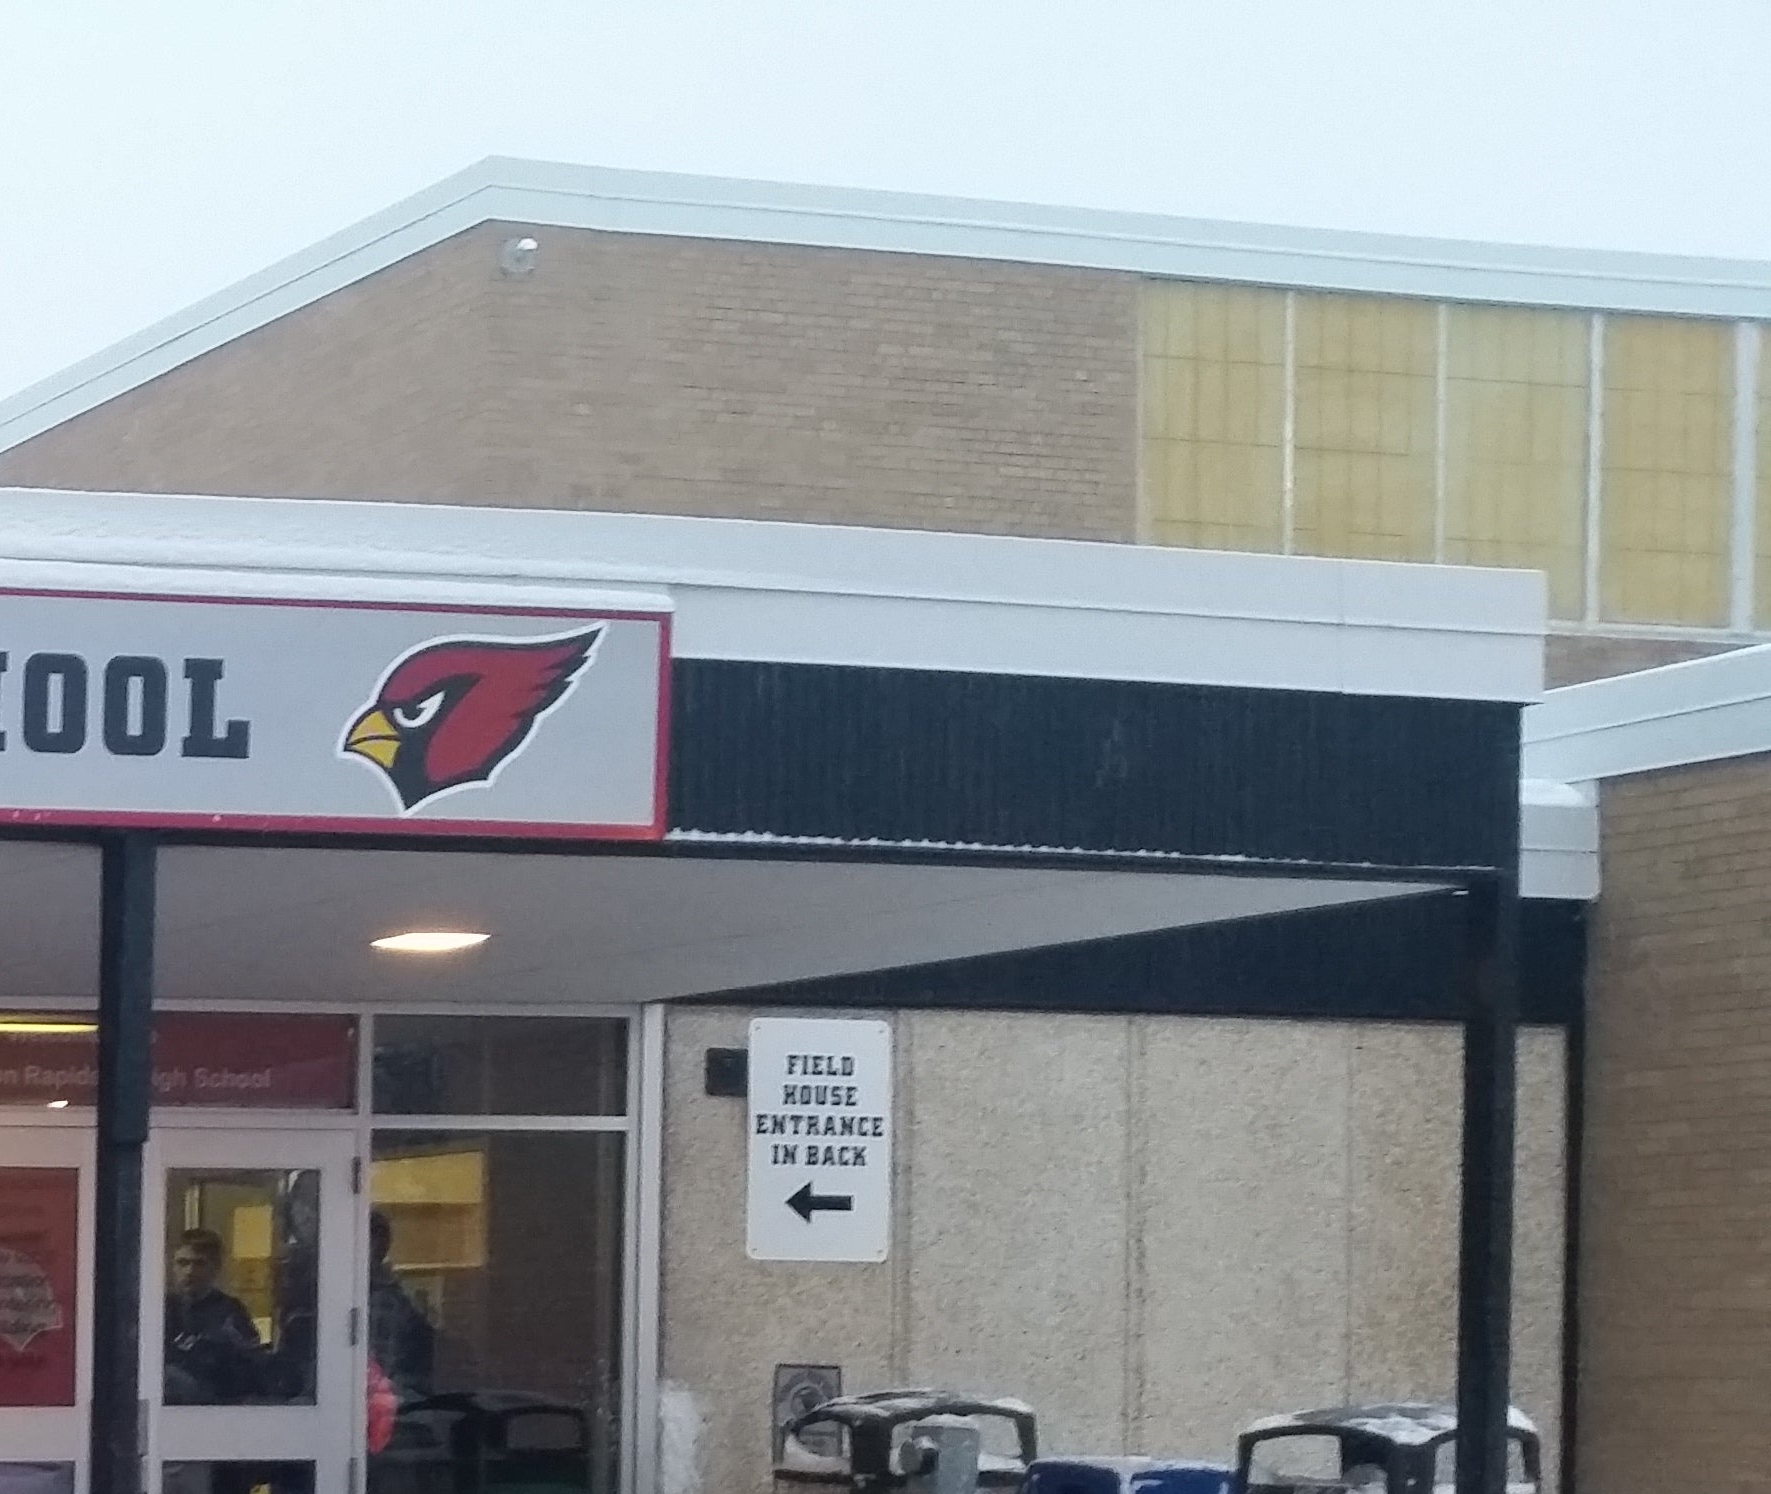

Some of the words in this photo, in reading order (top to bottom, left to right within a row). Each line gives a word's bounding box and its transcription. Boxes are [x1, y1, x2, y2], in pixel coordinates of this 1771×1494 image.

[786, 1054, 855, 1077] FIELD
[152, 1065, 187, 1092] igh
[193, 1066, 272, 1090] School
[782, 1083, 858, 1107] HOUSE
[755, 1113, 884, 1137] ENTRANCE
[771, 1143, 799, 1166] IN
[804, 1144, 867, 1167] BACK
